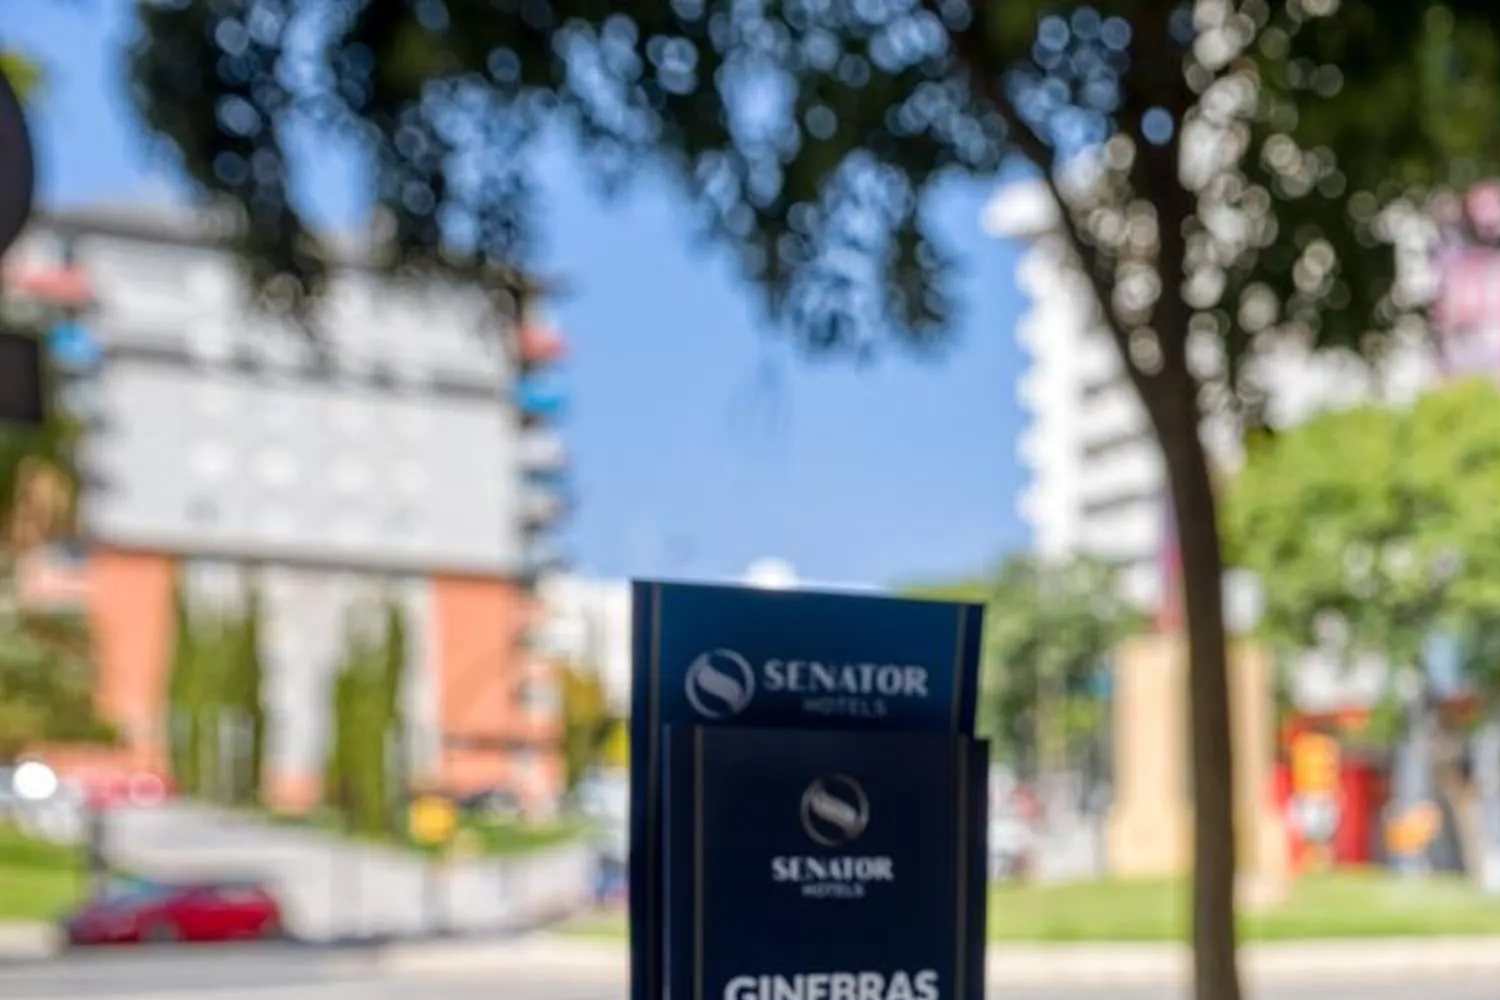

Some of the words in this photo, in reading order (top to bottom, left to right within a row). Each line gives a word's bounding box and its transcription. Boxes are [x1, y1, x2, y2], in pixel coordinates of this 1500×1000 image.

[764, 659, 928, 697] SENATOR
[804, 699, 887, 717] HOTELS
[772, 857, 893, 881] SENATOR
